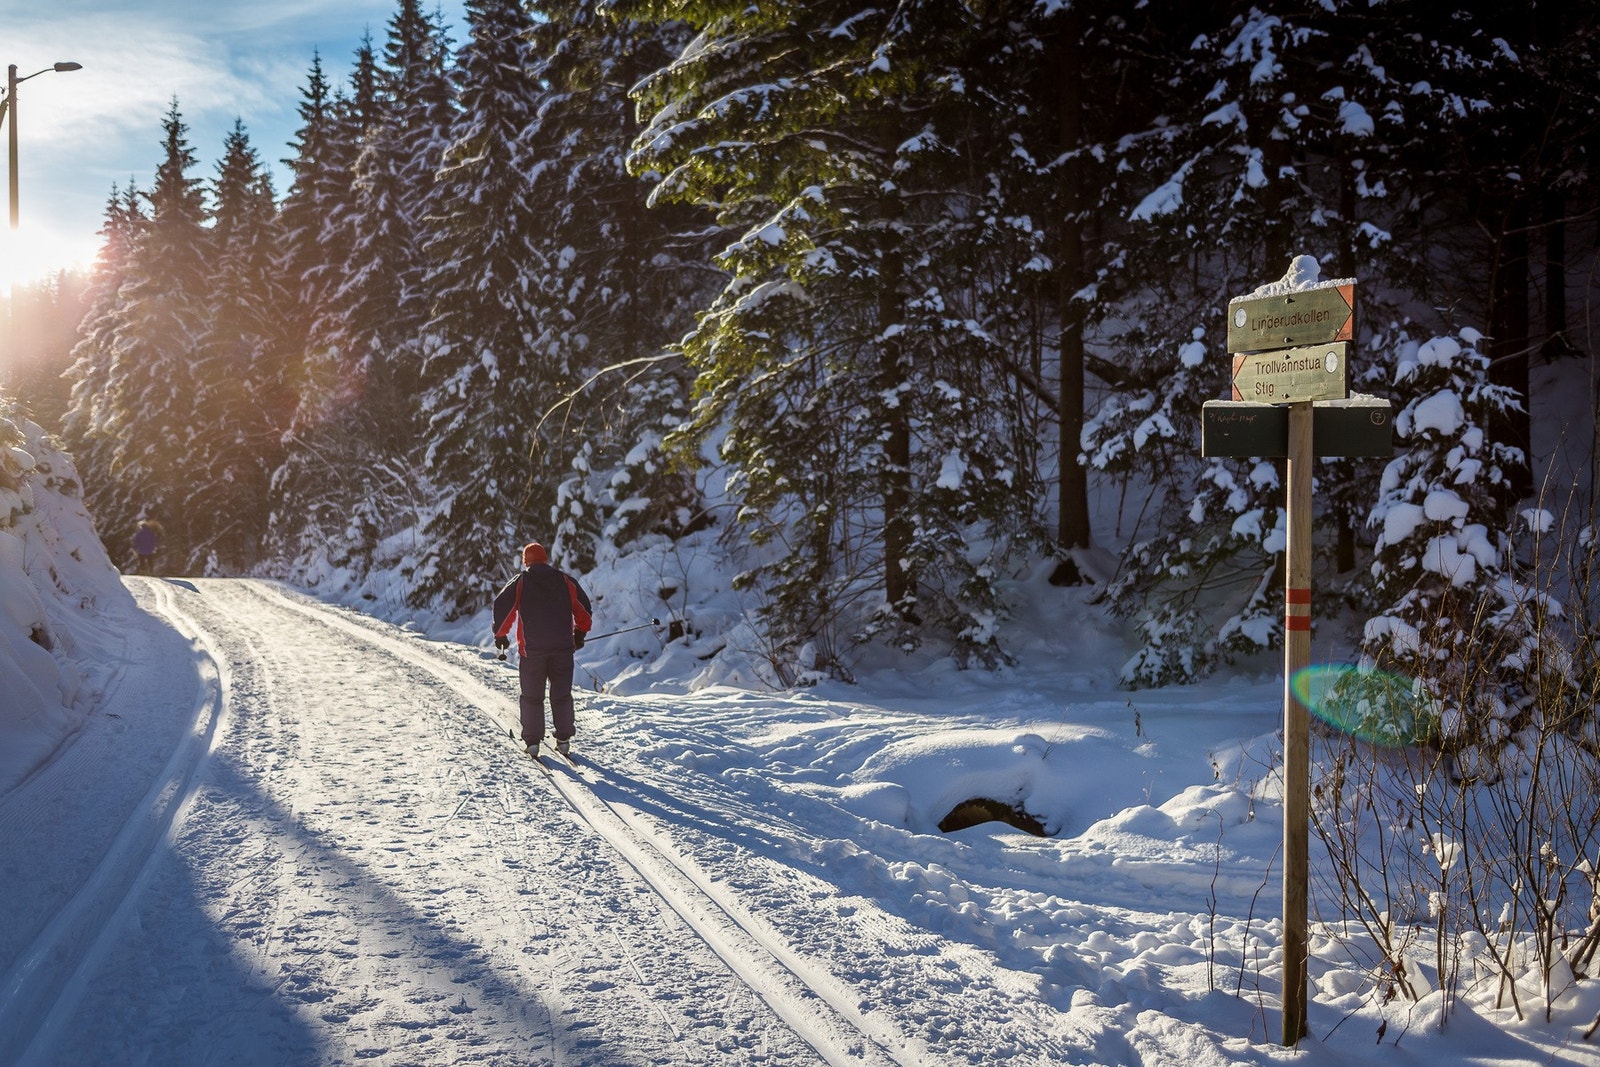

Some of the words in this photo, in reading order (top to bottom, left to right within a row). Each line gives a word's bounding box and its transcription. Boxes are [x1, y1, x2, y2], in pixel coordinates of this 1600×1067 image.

[1252, 310, 1330, 331] Linderudkollen
[1255, 357, 1321, 375] Trollvannstua
[1255, 382, 1275, 397] Stig
